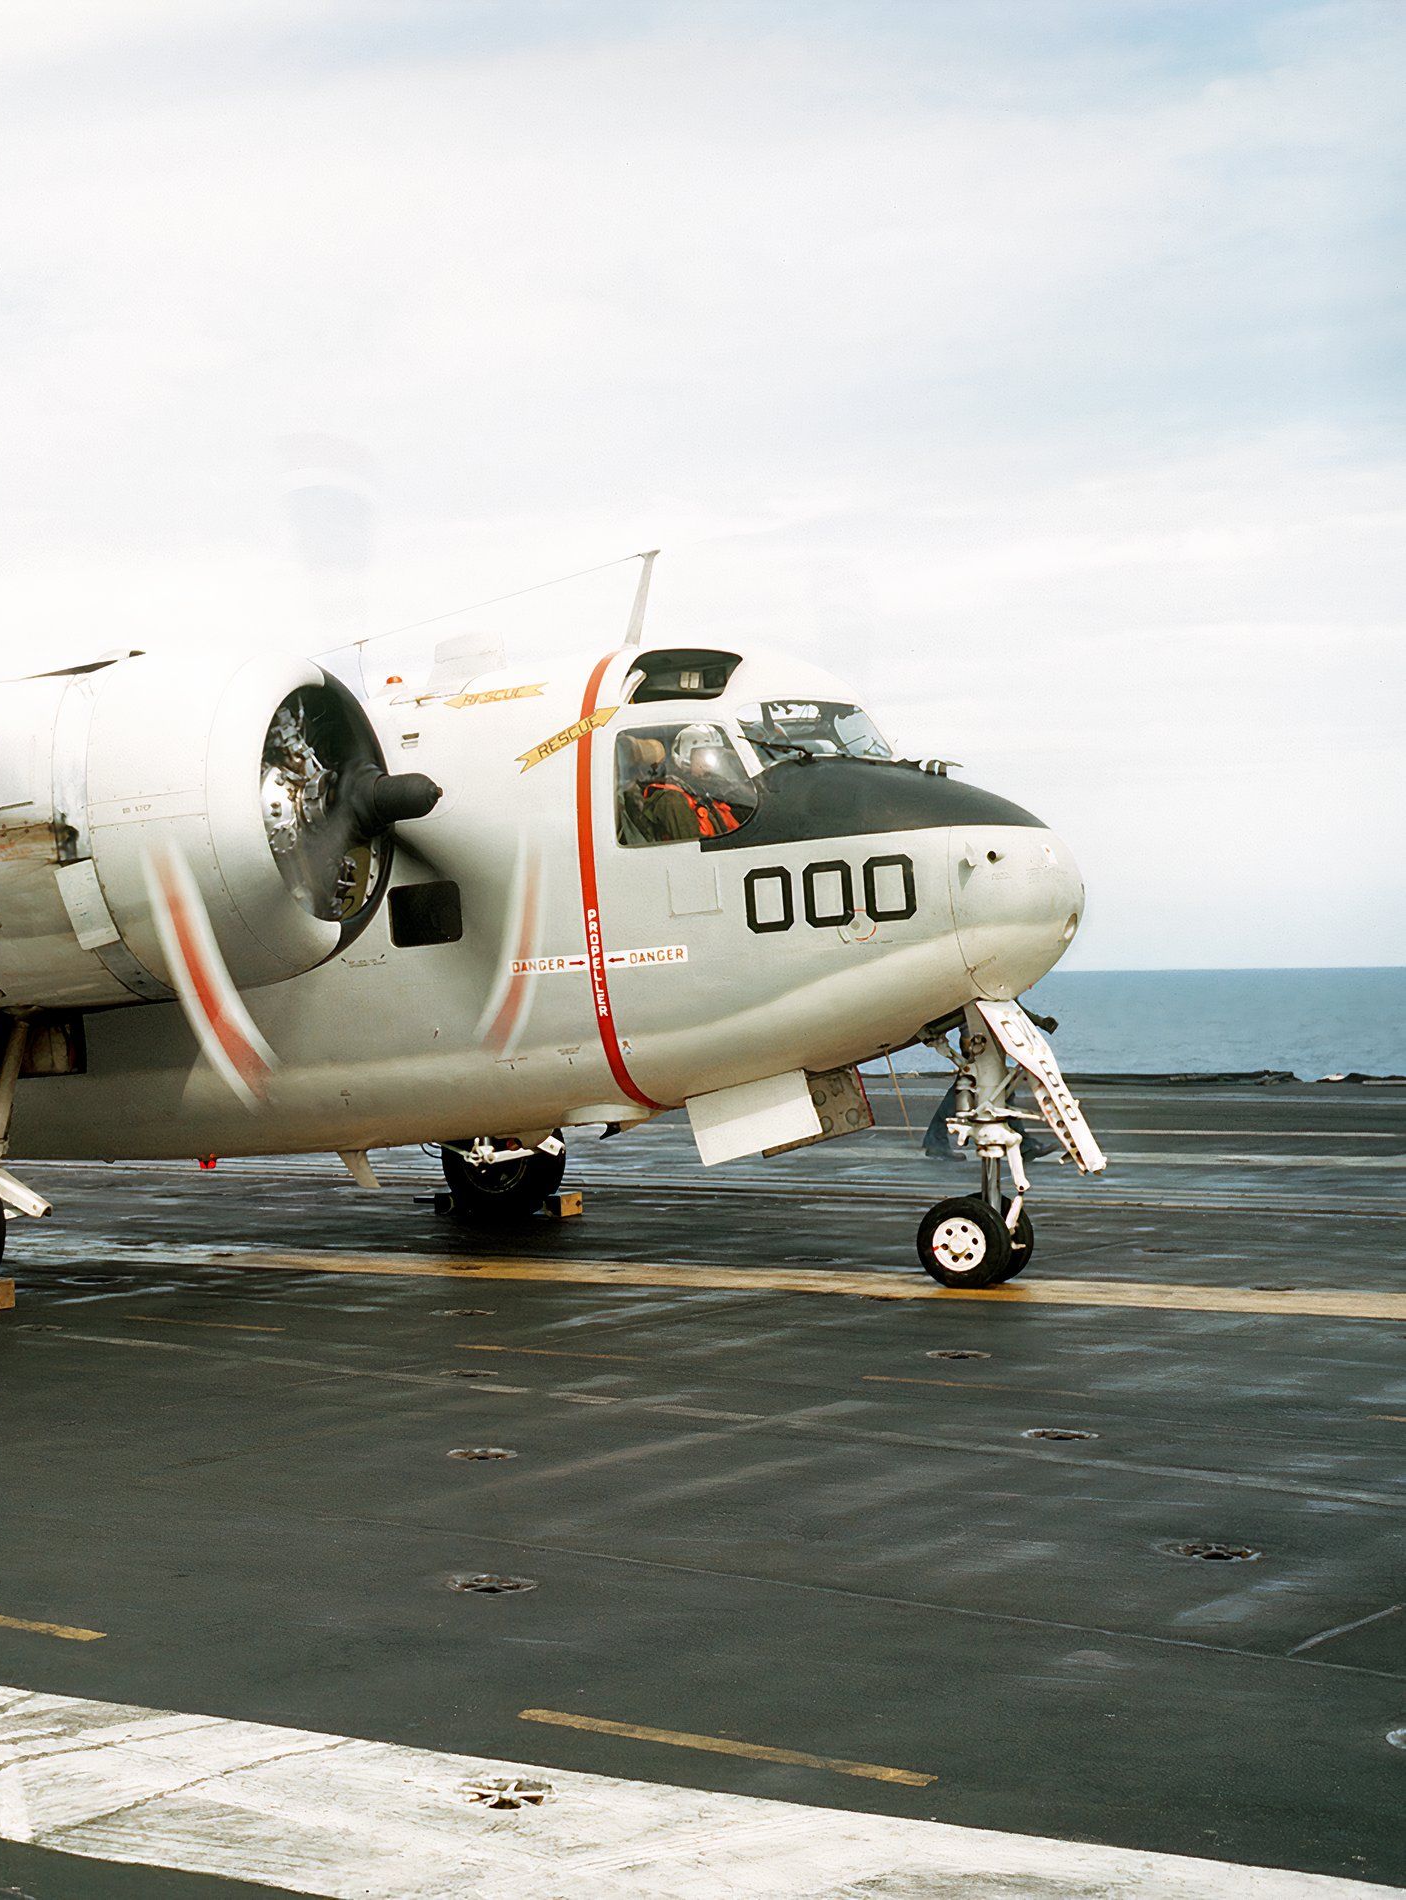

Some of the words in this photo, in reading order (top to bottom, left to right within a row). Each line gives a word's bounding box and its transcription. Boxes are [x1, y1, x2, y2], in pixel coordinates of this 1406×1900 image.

[537, 716, 597, 758] RESCUE
[743, 854, 917, 934] 000
[512, 958, 565, 974] DANGER
[587, 908, 608, 1017] PROPELLER
[629, 948, 684, 965] DANGER
